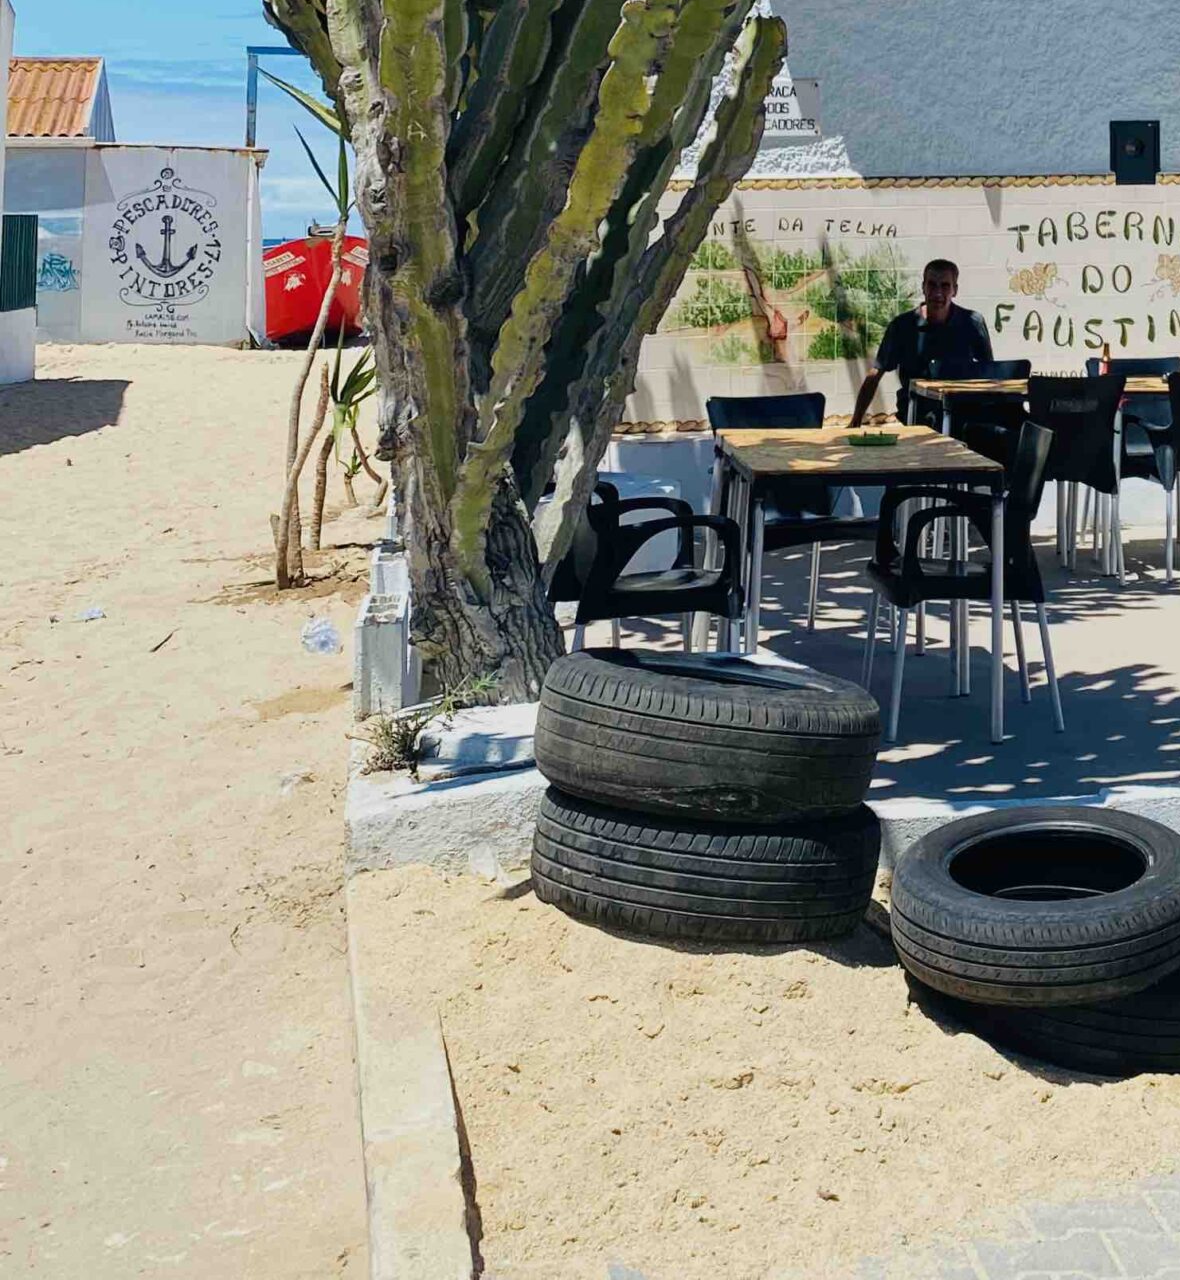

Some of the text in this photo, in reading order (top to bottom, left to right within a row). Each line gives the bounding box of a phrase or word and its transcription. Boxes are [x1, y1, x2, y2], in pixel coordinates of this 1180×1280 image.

[769, 86, 797, 97] RACA
[764, 119, 815, 131] CADORES
[112, 194, 219, 235] PESCADORES
[778, 218, 804, 232] DA
[824, 218, 898, 237] TELHA
[110, 253, 214, 297] PINTORES
[1082, 264, 1132, 294] DO
